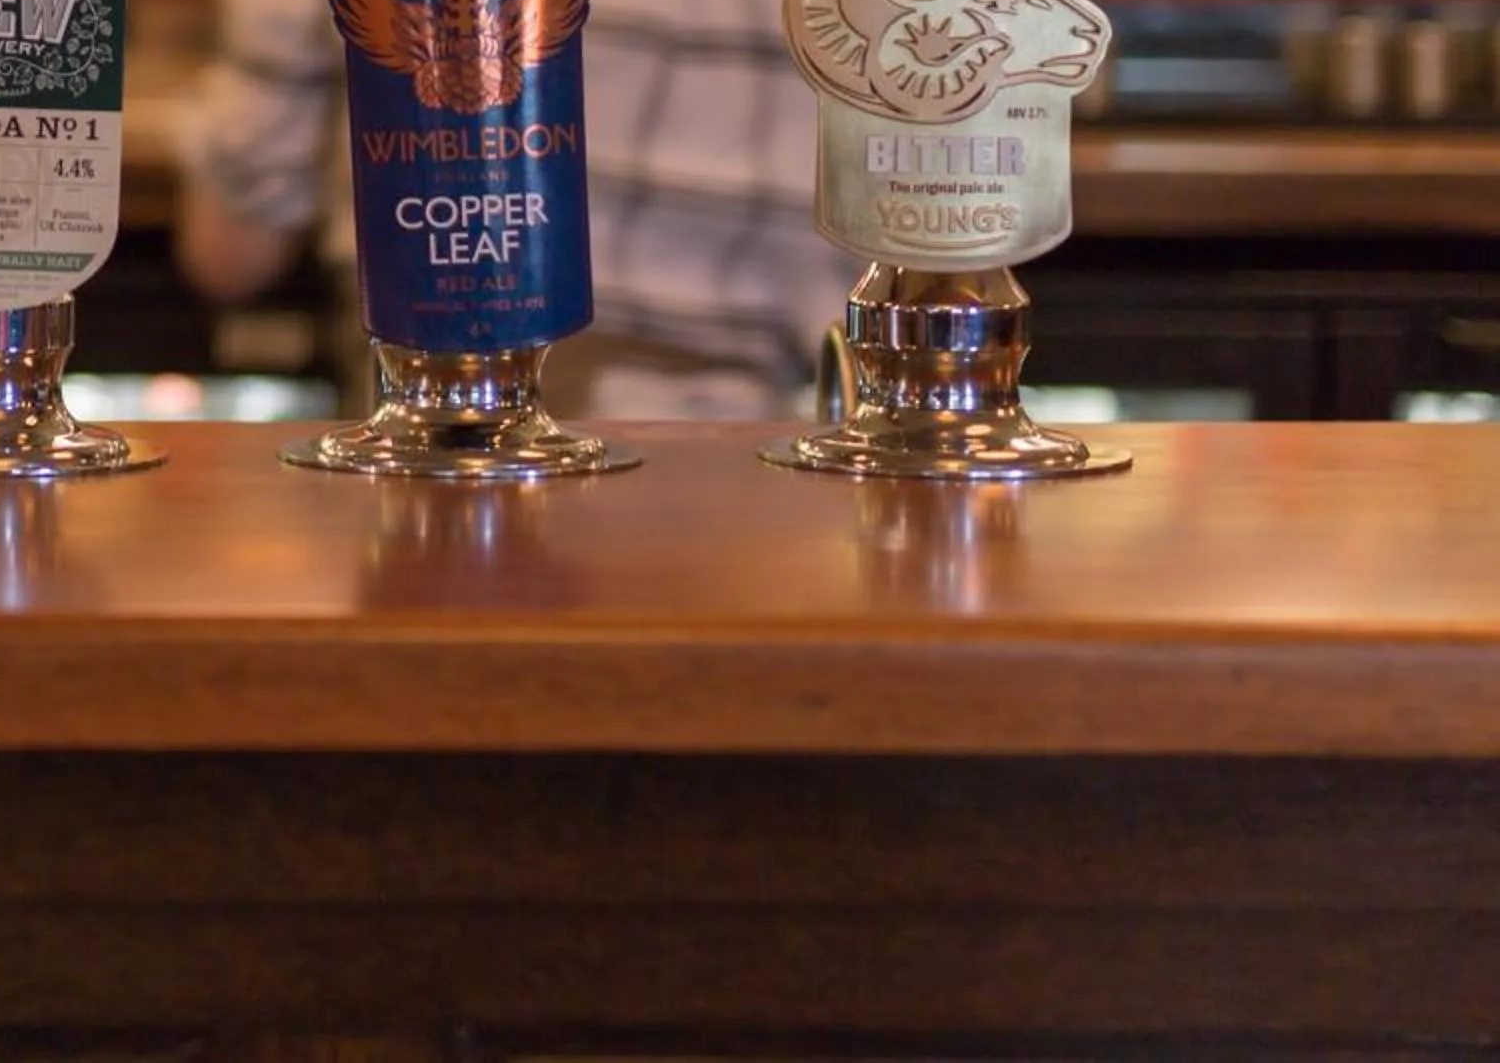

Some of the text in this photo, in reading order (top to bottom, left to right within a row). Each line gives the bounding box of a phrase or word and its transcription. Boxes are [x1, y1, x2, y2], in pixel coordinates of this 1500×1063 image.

[1006, 106, 1028, 119] ABV
[363, 122, 577, 164] WIMBLEDON
[865, 135, 1028, 176] BITTER
[53, 158, 96, 179] 4.4%
[889, 180, 1006, 196] The original pale ale
[395, 192, 549, 230] COPPER
[877, 199, 1020, 235] YOUNG'S
[428, 229, 520, 266] LEAF
